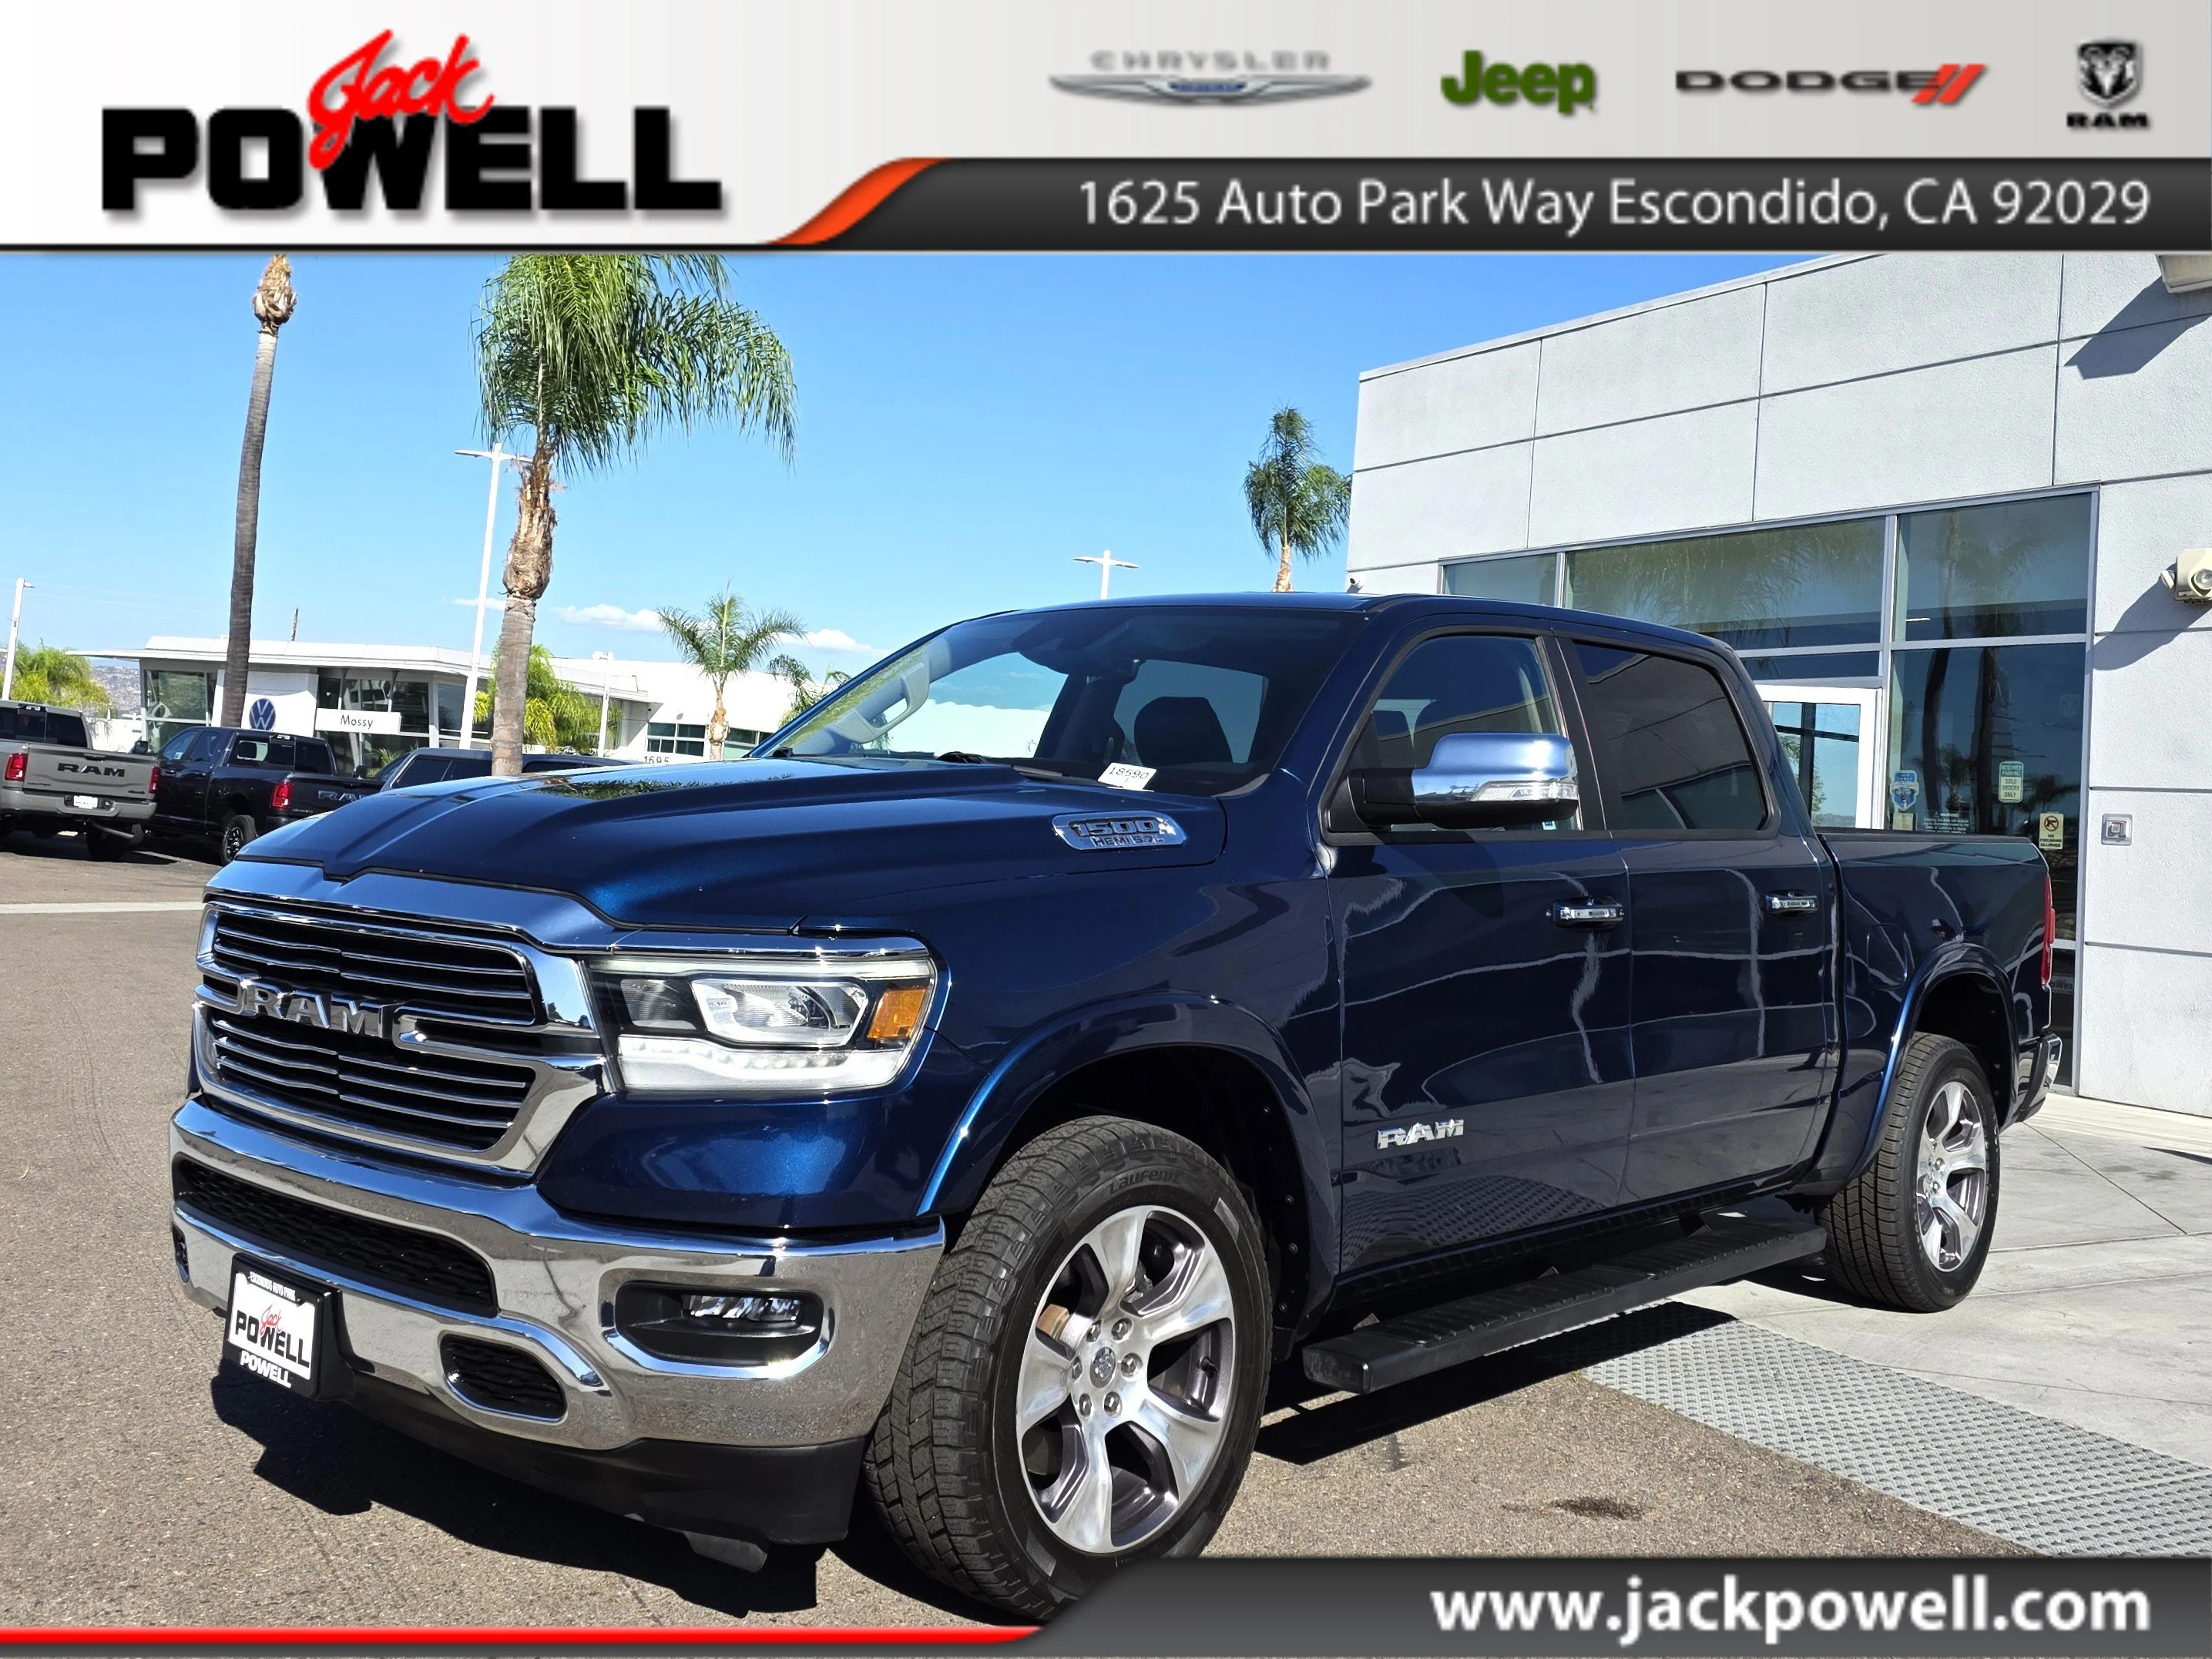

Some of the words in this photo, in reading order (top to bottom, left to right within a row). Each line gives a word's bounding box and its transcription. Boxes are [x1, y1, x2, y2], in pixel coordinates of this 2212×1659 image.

[340, 714, 374, 730] Mossy
[57, 762, 126, 777] RAM
[1108, 767, 1150, 780] 18590
[317, 790, 366, 802] RA
[1069, 819, 1160, 838] 1500
[1091, 835, 1131, 848] HEMI
[240, 979, 383, 1039] RAM
[1377, 1119, 1465, 1150] RAM
[235, 1310, 310, 1369] POWELL
[240, 1350, 292, 1389] POWELL
